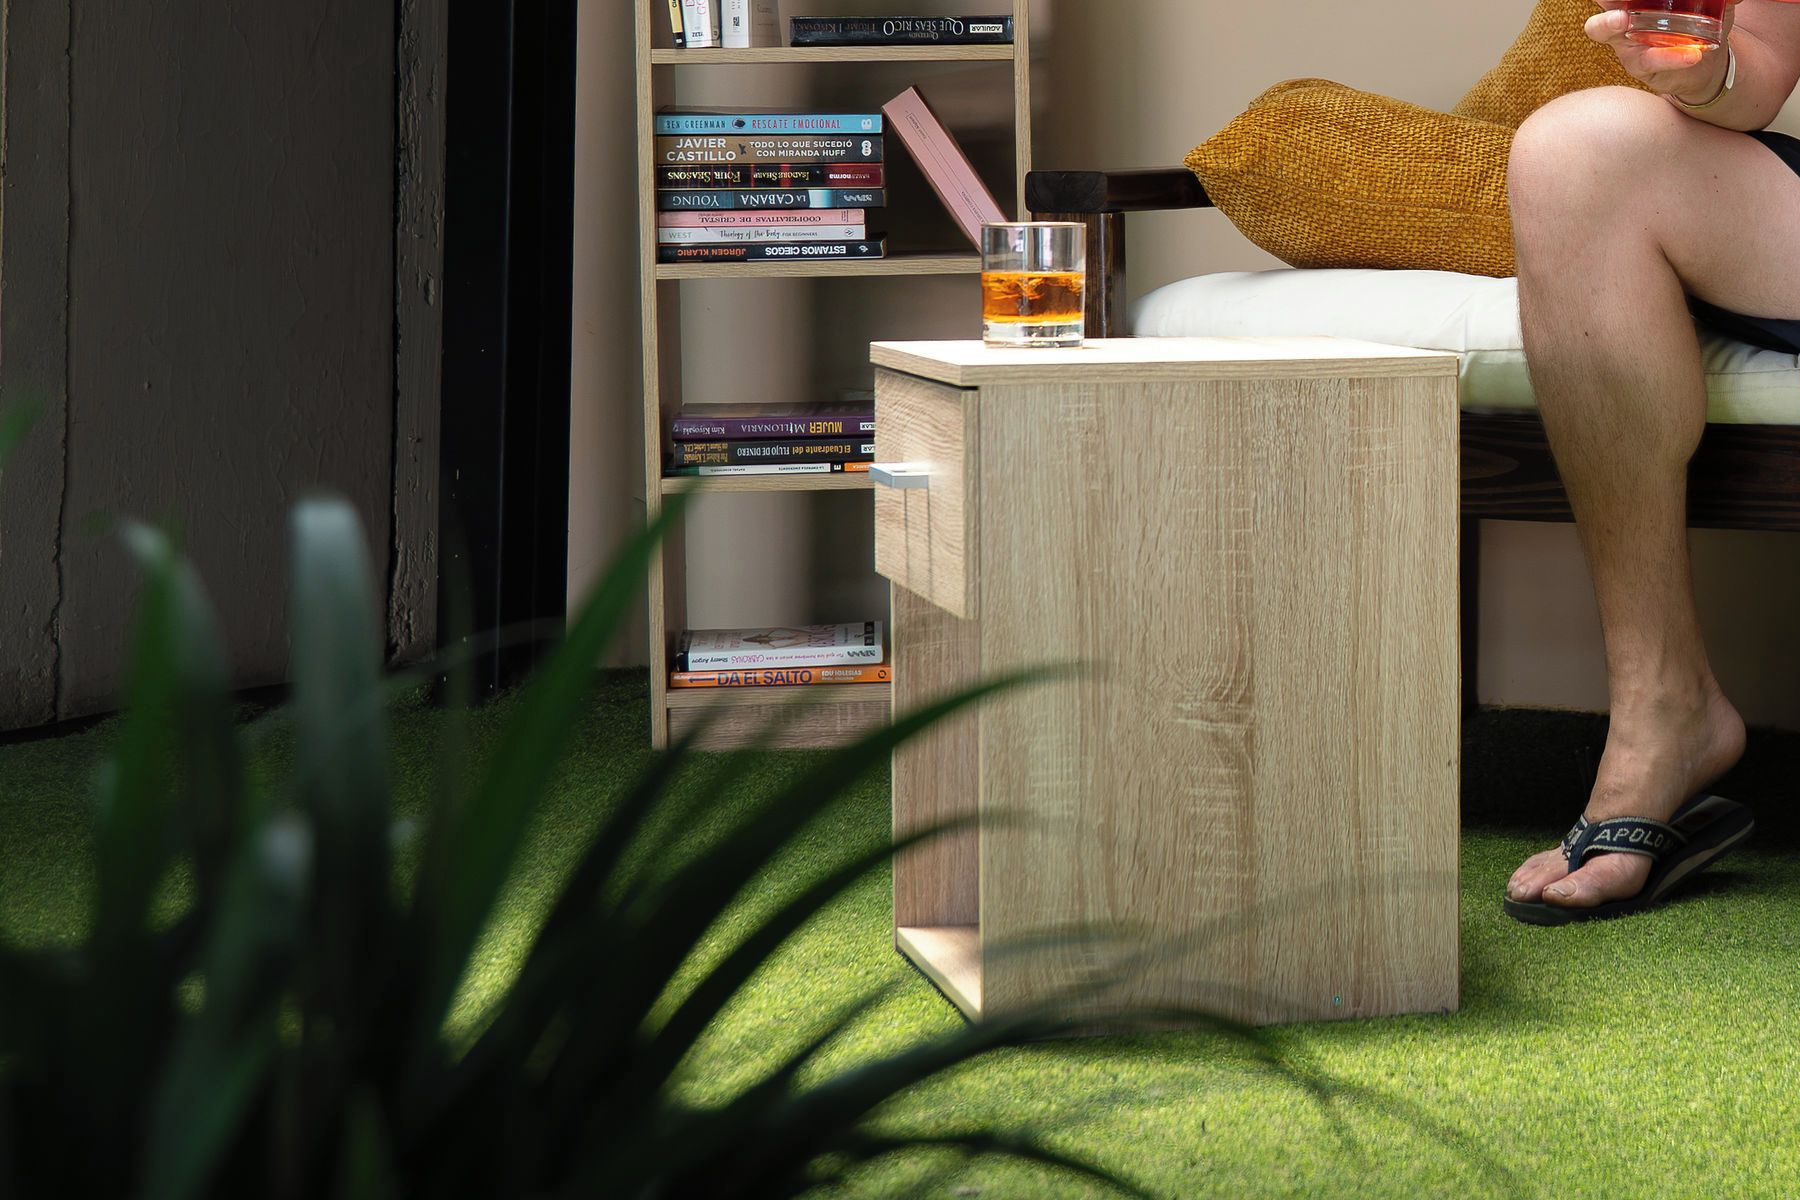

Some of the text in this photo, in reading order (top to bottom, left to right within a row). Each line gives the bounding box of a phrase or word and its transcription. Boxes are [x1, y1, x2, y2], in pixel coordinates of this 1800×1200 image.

[915, 20, 936, 31] SEAS
[667, 120, 726, 129] BEN GREENMAN
[752, 119, 840, 129] RESCATE EMOCIONAL
[676, 138, 727, 148] JAVIER
[813, 138, 853, 148] SUCEDIÓ
[666, 151, 736, 161] CASTILLO
[667, 171, 741, 183] FOUR SEASONS
[673, 195, 719, 206] YOUNG
[740, 194, 794, 206] CABAÑA
[720, 230, 743, 240] Theology
[745, 231, 751, 239] of
[677, 248, 746, 257] JÜRGEN KLARIC
[765, 246, 847, 256] ESTAMOS CIEGOS
[741, 422, 842, 434] MUJER MILLONARIA
[737, 445, 851, 456] El Cuadrante del FLUJO DE DINERO
[717, 670, 812, 685] DA EL SALTO
